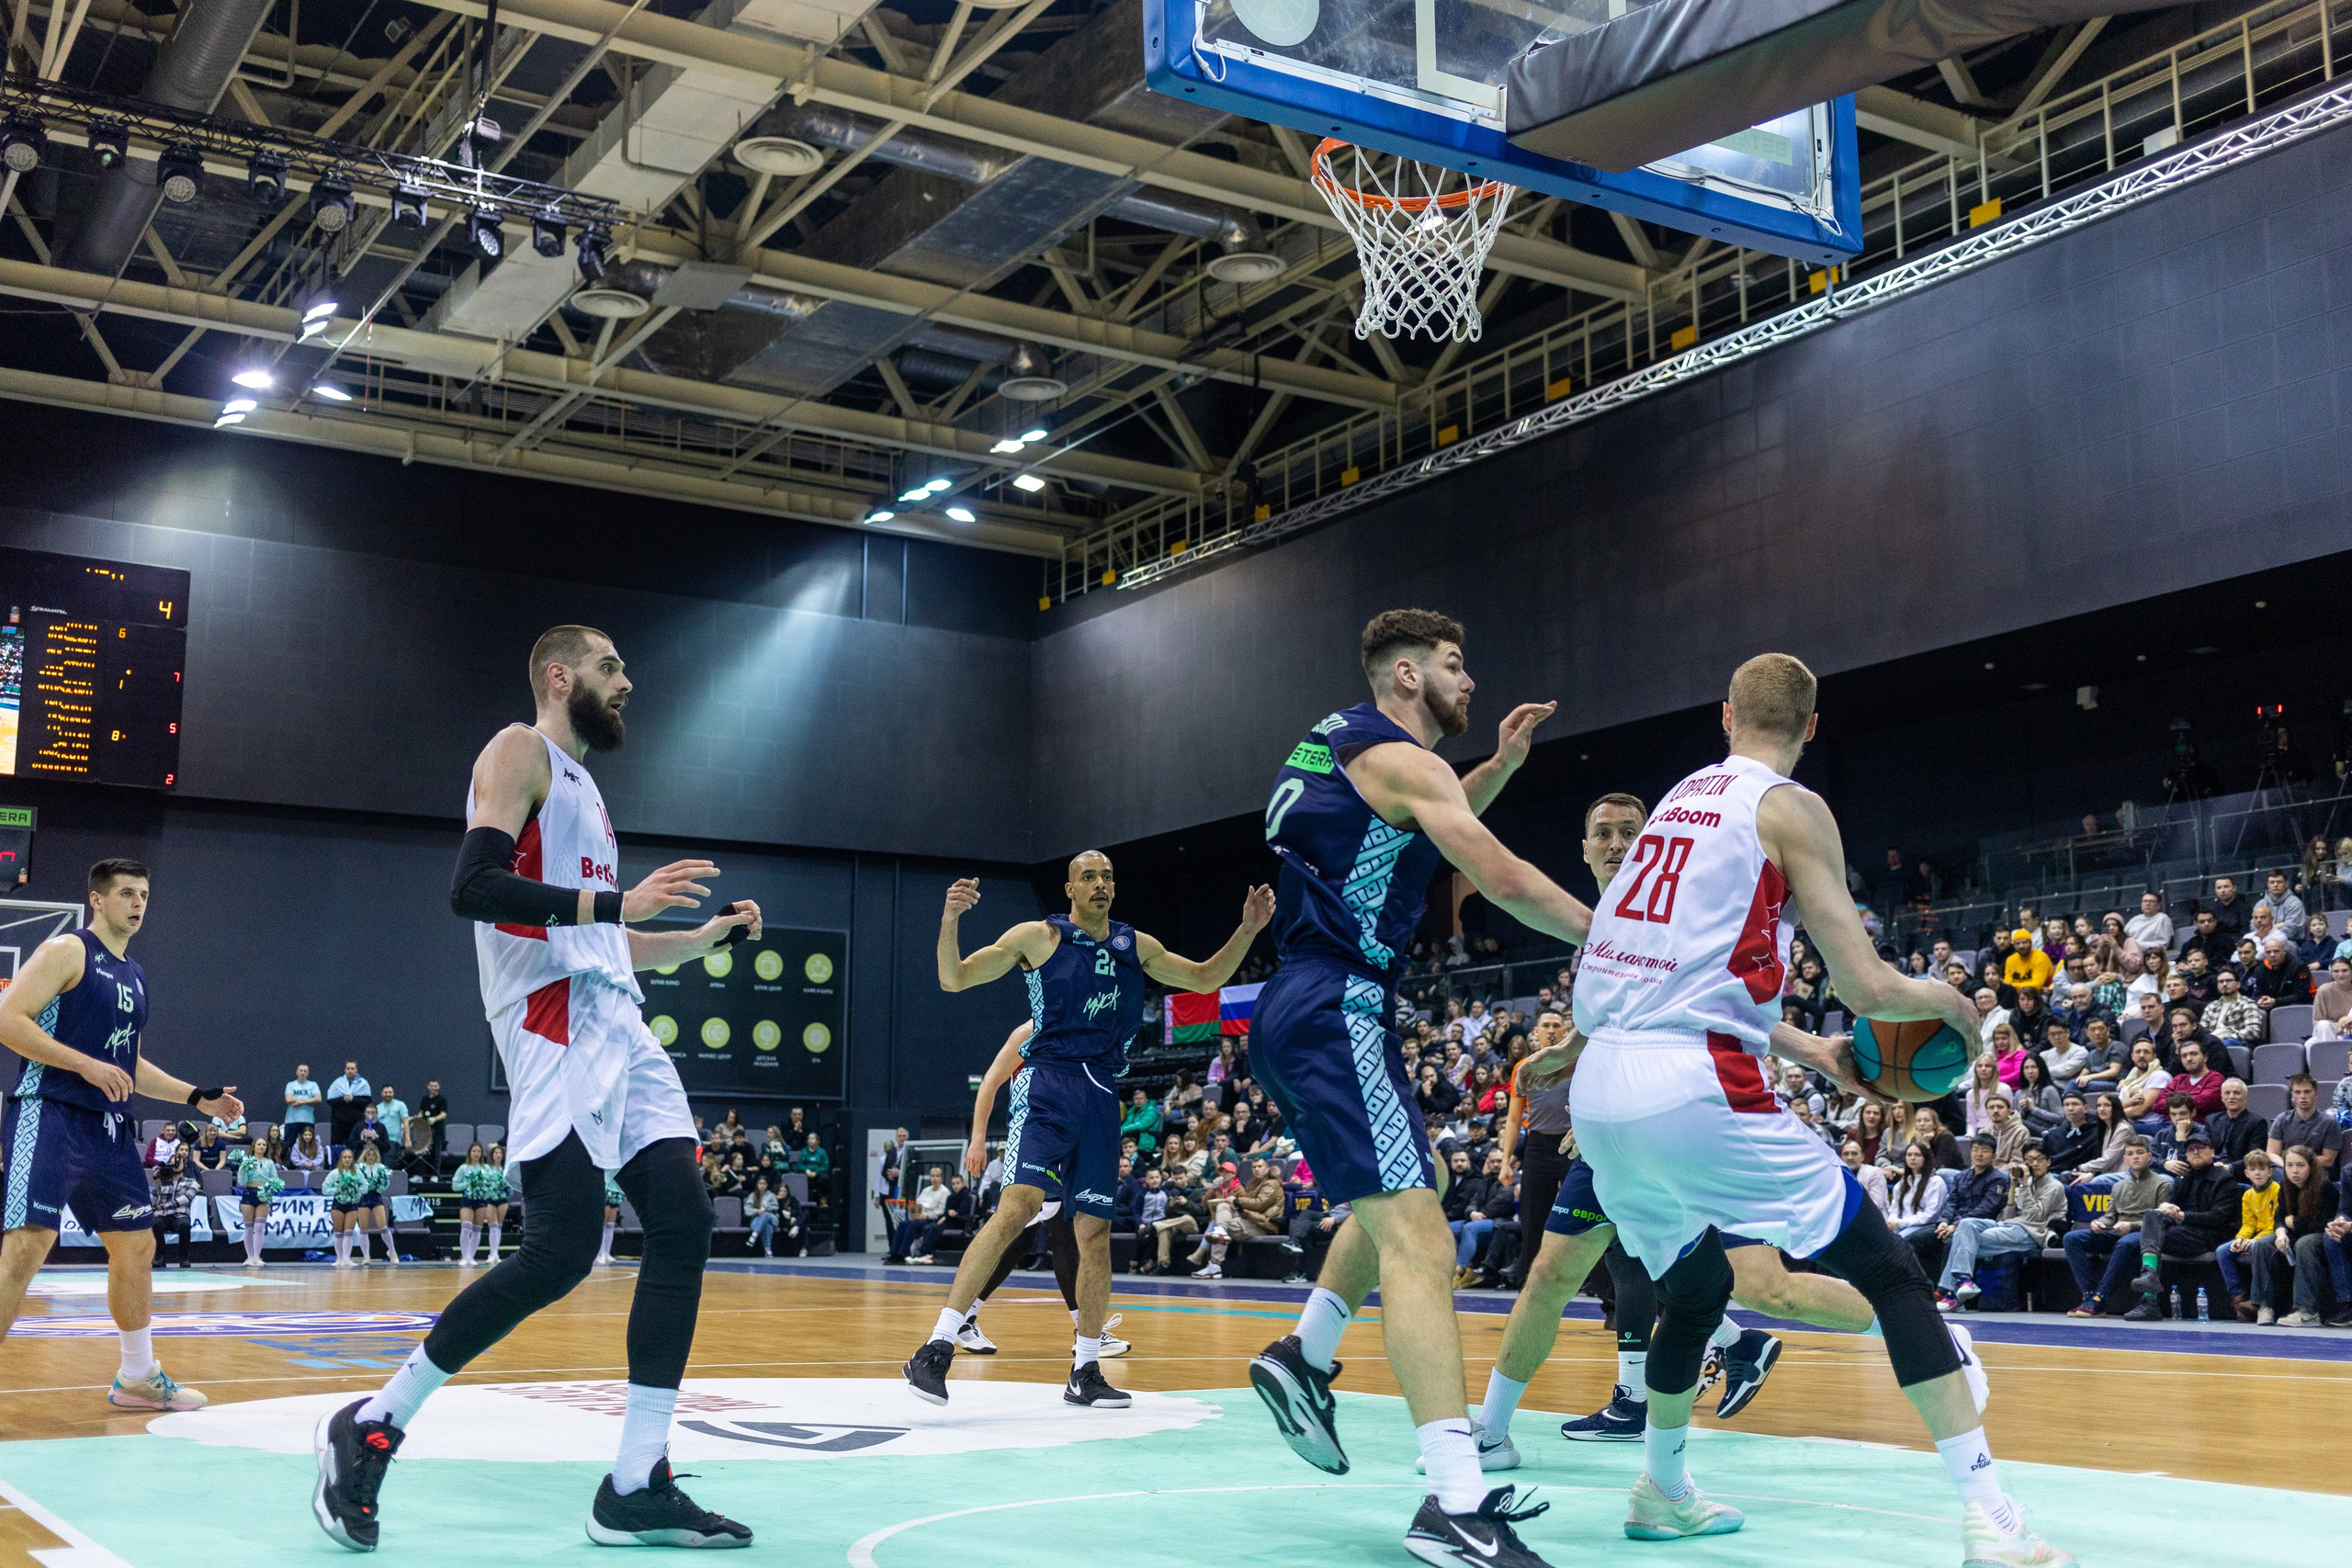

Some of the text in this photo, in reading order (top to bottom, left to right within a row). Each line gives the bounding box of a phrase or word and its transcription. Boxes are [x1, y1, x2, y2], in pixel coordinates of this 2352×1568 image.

[159, 601, 172, 619] 4
[119, 627, 126, 638] 6
[174, 671, 180, 682] 7
[169, 722, 176, 734] 5
[111, 729, 120, 741] 8
[165, 773, 174, 785] 2
[1669, 775, 1738, 803] LOPATIN
[1614, 834, 1694, 924] 28
[117, 982, 134, 1013] 15
[1022, 1162, 1046, 1173] Kempa
[33, 1201, 57, 1213] Kempa
[1971, 1459, 1992, 1472] PEAK
